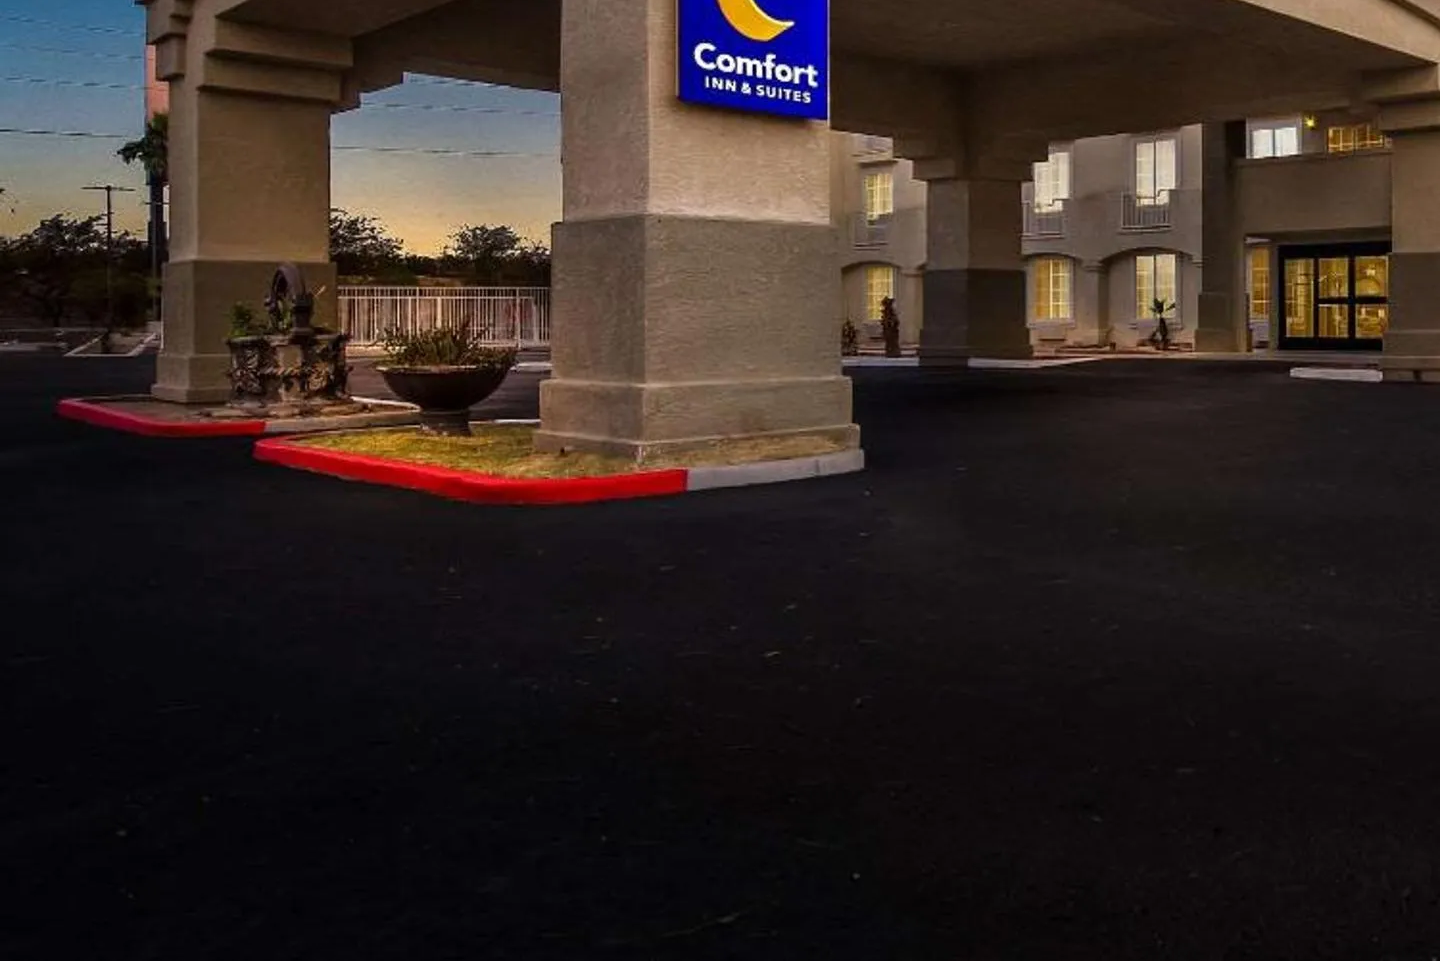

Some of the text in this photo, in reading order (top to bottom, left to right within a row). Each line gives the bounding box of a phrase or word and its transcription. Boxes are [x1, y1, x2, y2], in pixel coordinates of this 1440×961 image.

[693, 42, 818, 88] Comfort
[705, 75, 811, 104] INN & SUITES
